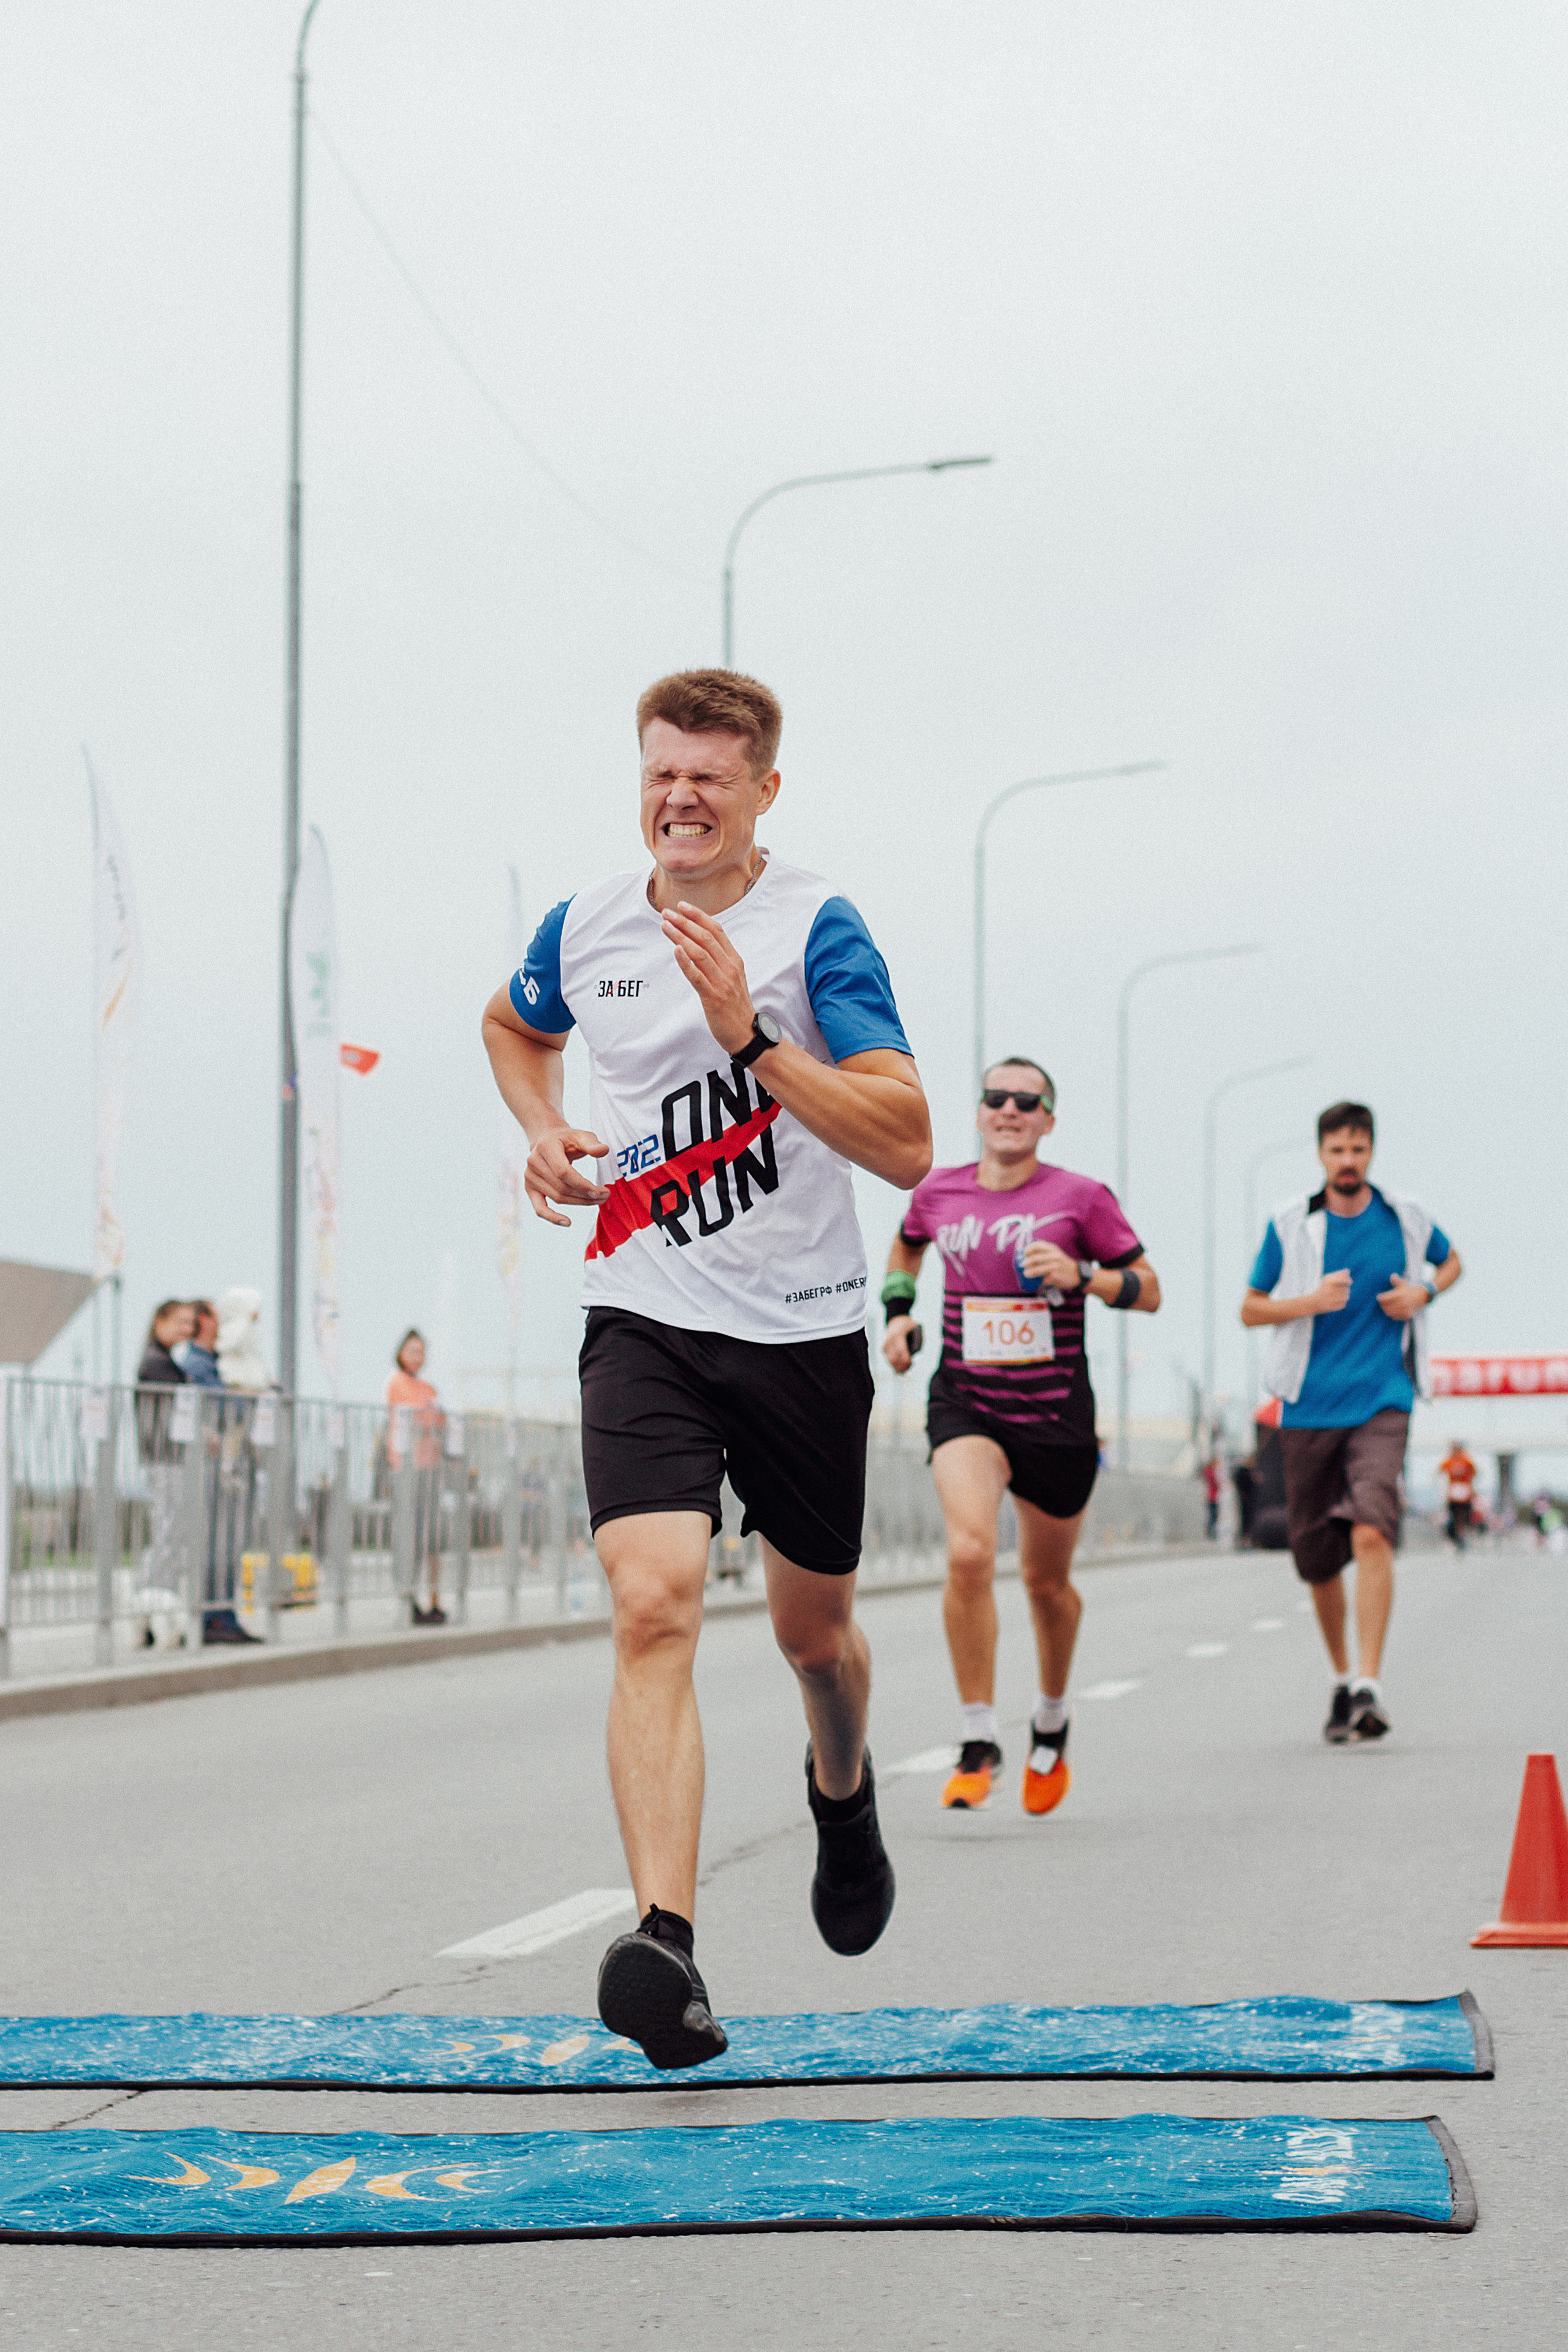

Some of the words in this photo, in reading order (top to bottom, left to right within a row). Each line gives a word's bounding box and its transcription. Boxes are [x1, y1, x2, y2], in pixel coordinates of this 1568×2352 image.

[650, 1123, 779, 1247] RUN
[785, 1286, 832, 1303] #ЗАБЕГРФ
[984, 1320, 1035, 1346] 106
